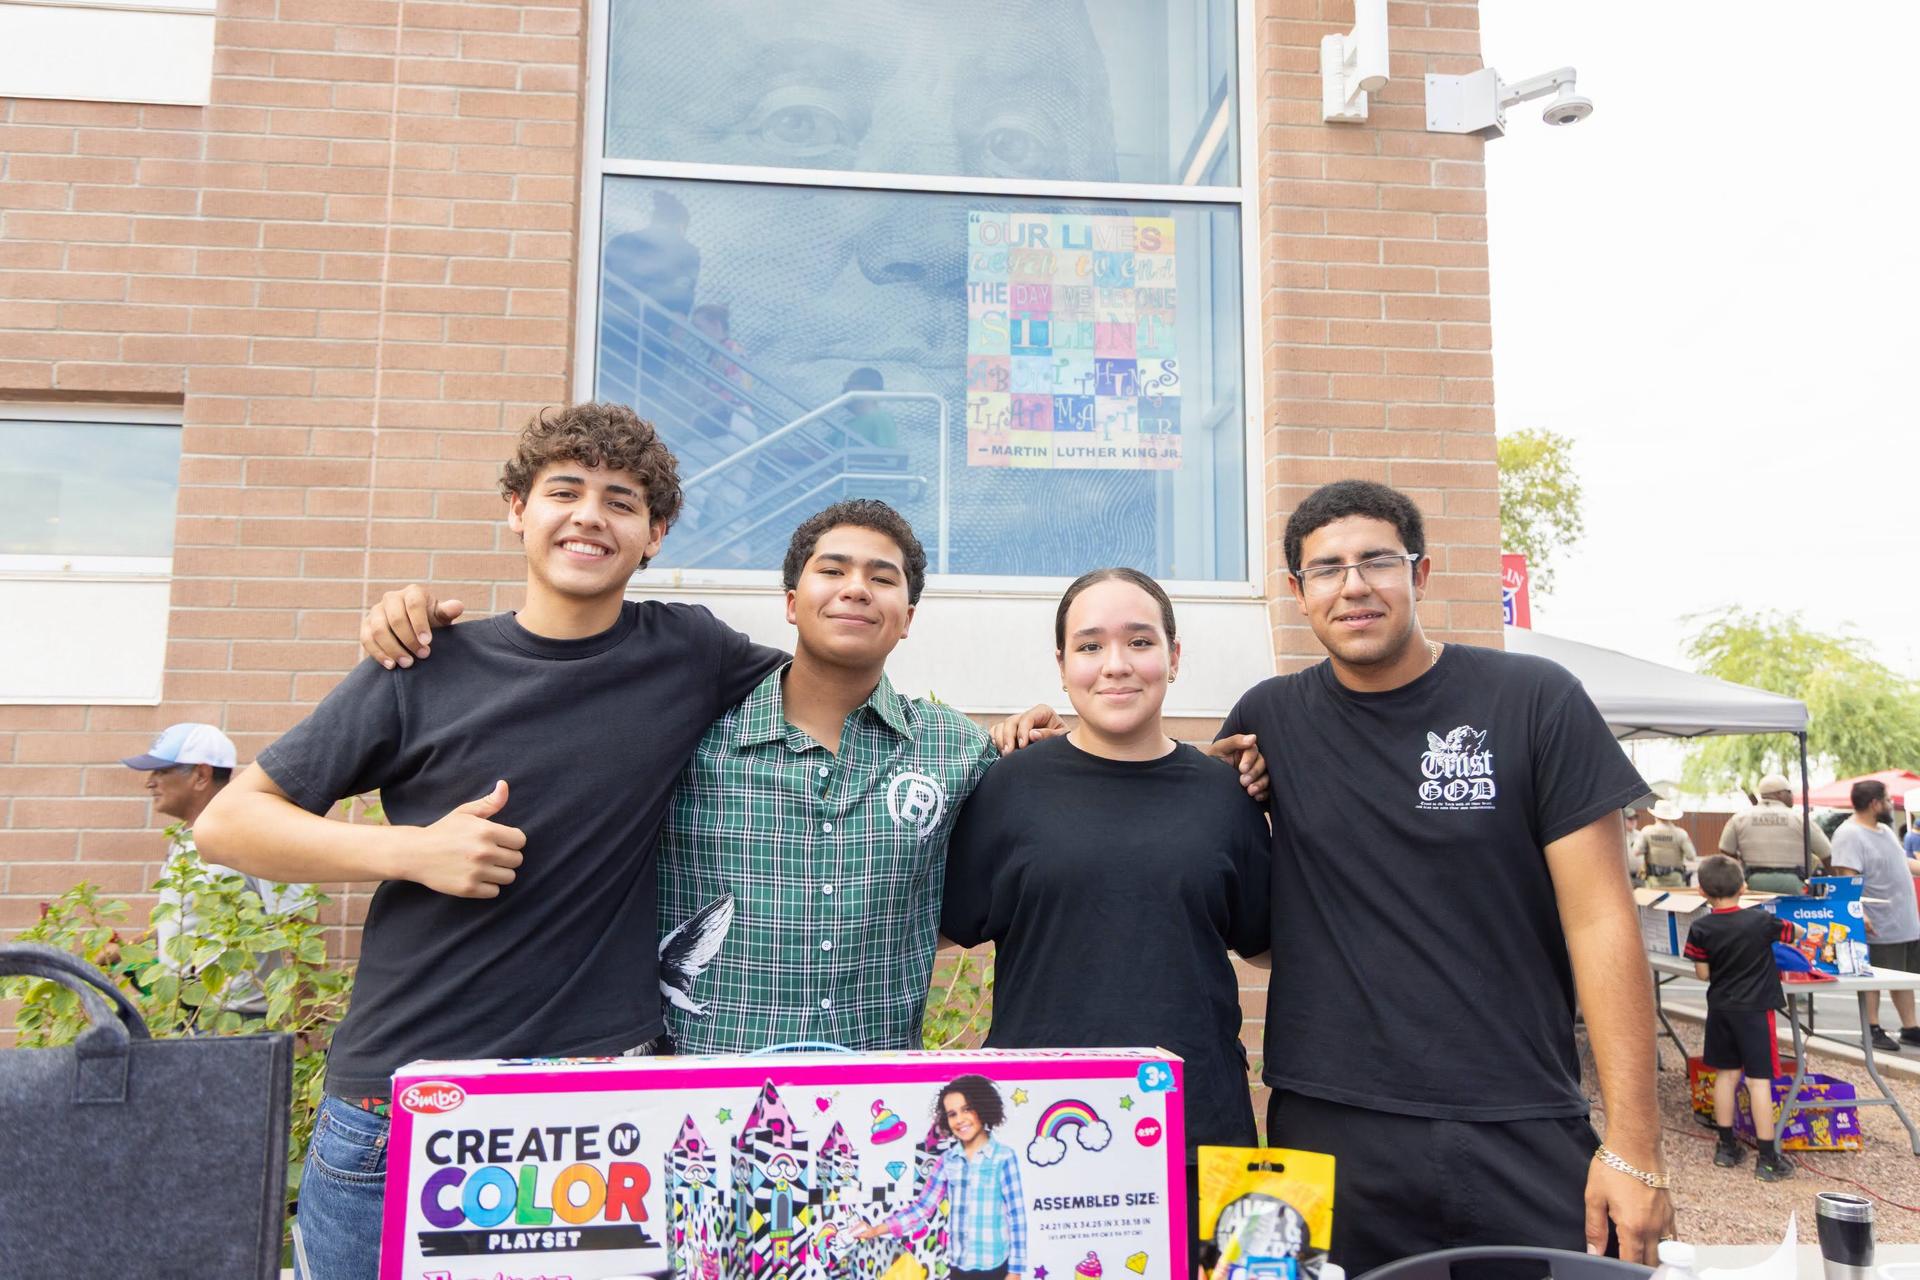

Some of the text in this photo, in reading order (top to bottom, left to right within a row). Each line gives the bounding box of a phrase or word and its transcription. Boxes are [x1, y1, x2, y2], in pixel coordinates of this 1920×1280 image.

[1062, 223, 1162, 251] LIVES
[968, 282, 1008, 304] THE
[1016, 284, 1049, 305] DAY
[1064, 286, 1091, 307] WE
[981, 311, 1176, 351] SILENT
[991, 445, 1047, 457] MARTIN
[1057, 446, 1117, 458] LUTHER
[1122, 447, 1157, 459] KING
[1421, 749, 1494, 779] Trust
[1418, 777, 1496, 802] GOD
[1793, 907, 1835, 919] classic
[1145, 1065, 1167, 1087] 3+
[425, 1124, 601, 1165] CREATE
[420, 1162, 651, 1228] COLOR
[1033, 1191, 1160, 1211] ASSEMBLED SIZE:
[488, 1231, 581, 1249] PLAYSET
